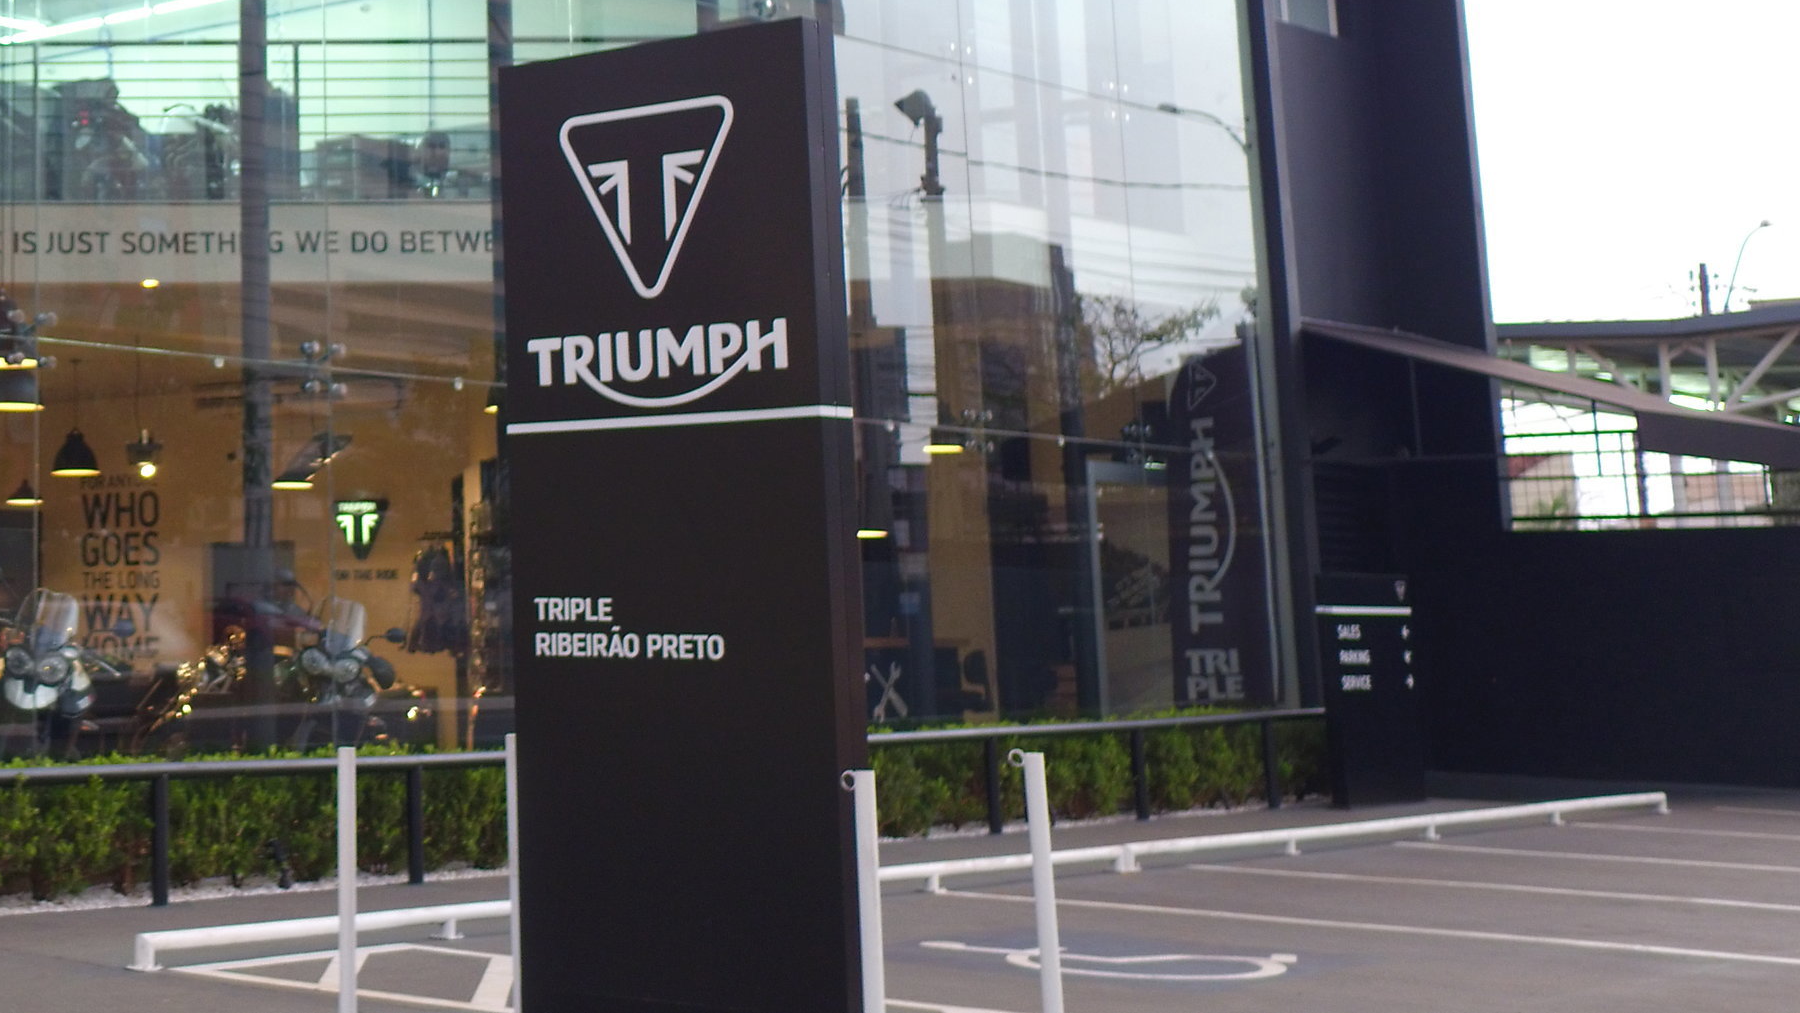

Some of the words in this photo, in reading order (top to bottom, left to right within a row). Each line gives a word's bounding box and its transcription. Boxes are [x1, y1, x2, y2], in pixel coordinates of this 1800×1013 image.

[13, 231, 37, 255] IS
[46, 231, 109, 255] JUST
[122, 230, 283, 255] SOMETHG
[296, 230, 339, 254] WE
[352, 230, 388, 254] DO
[400, 230, 493, 254] BETWE
[527, 317, 788, 408] TRIUMPH
[82, 491, 160, 529] WHO
[1189, 416, 1236, 634] TRIUMPH
[81, 531, 160, 568] GOES
[83, 571, 112, 589] THE
[118, 571, 161, 589] LONG
[84, 593, 159, 632] WAY
[534, 597, 612, 622] TRIPLE
[535, 626, 640, 657] RIBEIRÃO
[647, 634, 725, 661] PRETO
[1185, 647, 1239, 675] TRI
[1187, 675, 1245, 701] PLE
